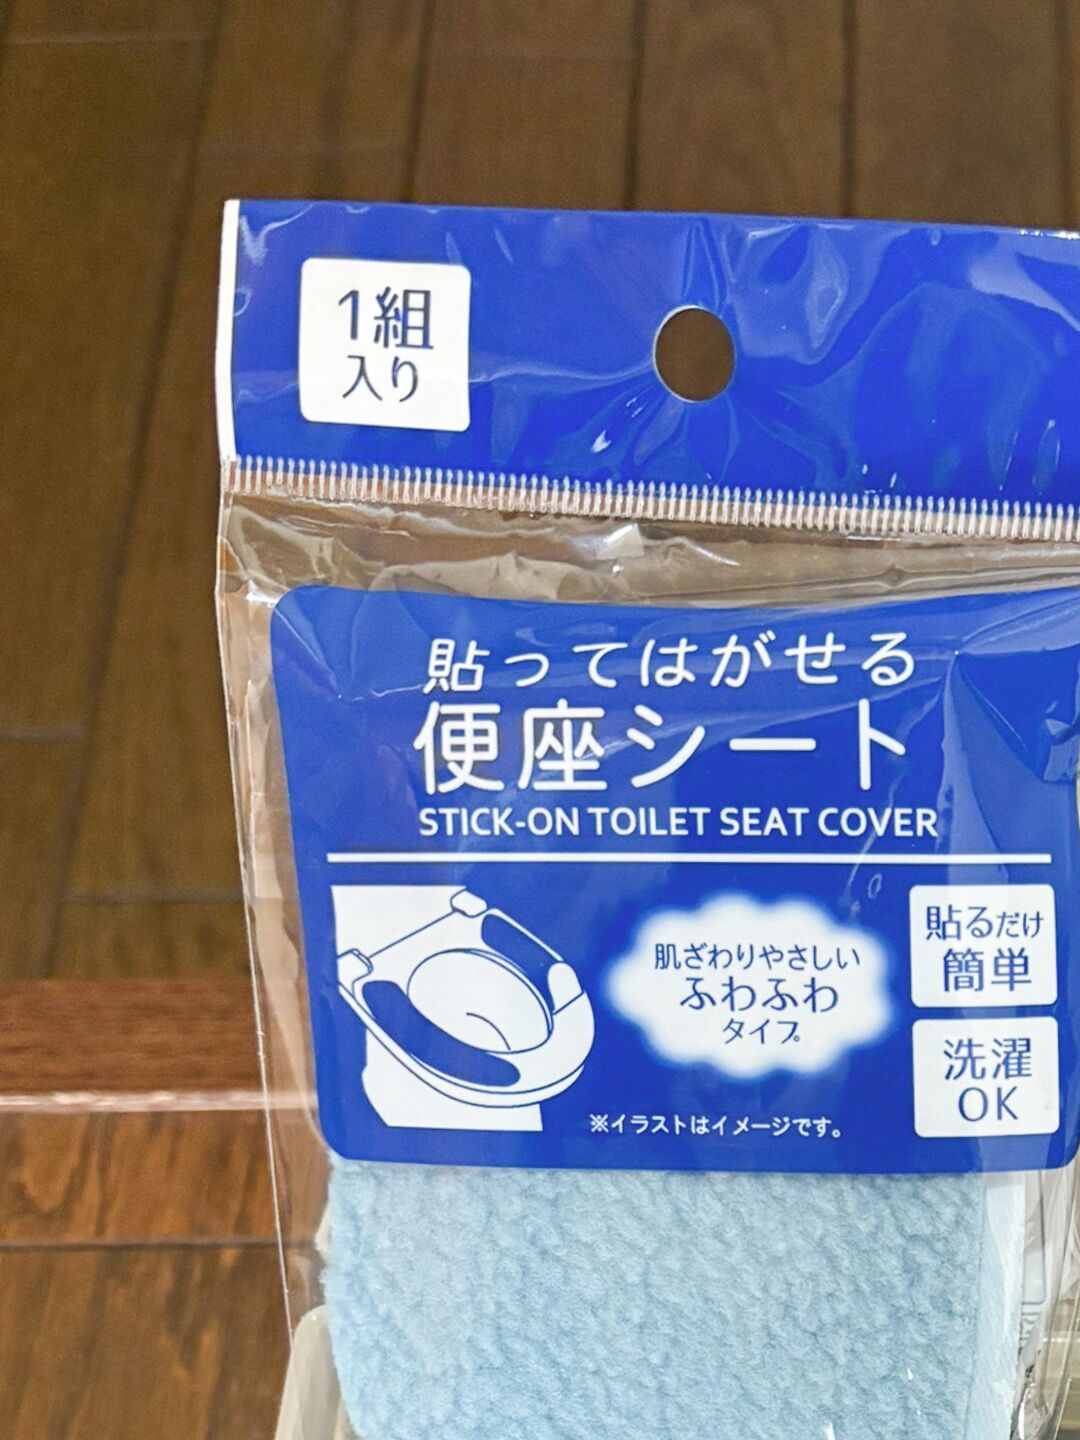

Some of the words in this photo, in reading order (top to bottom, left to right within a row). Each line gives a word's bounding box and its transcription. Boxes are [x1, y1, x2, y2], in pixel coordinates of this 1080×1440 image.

[337, 285, 434, 350] 1組
[341, 354, 419, 403] 入り
[422, 631, 915, 695] 貼ってはがせる
[412, 698, 907, 795] 便座シート
[418, 807, 581, 837] STICK-ON
[587, 807, 711, 837] TOILET
[719, 807, 810, 837] SEAT
[817, 807, 939, 837] COVER
[925, 904, 1045, 941] 貼るだけ
[653, 942, 862, 971] 肌ざわりやさしい
[942, 946, 1033, 993] 簡単
[679, 975, 840, 1013] ふわふわ
[721, 1017, 802, 1044] タイプ
[942, 1037, 1034, 1081] 洗濯
[957, 1086, 1020, 1122] OK
[589, 1112, 842, 1139] ※イラストはイメージです。
